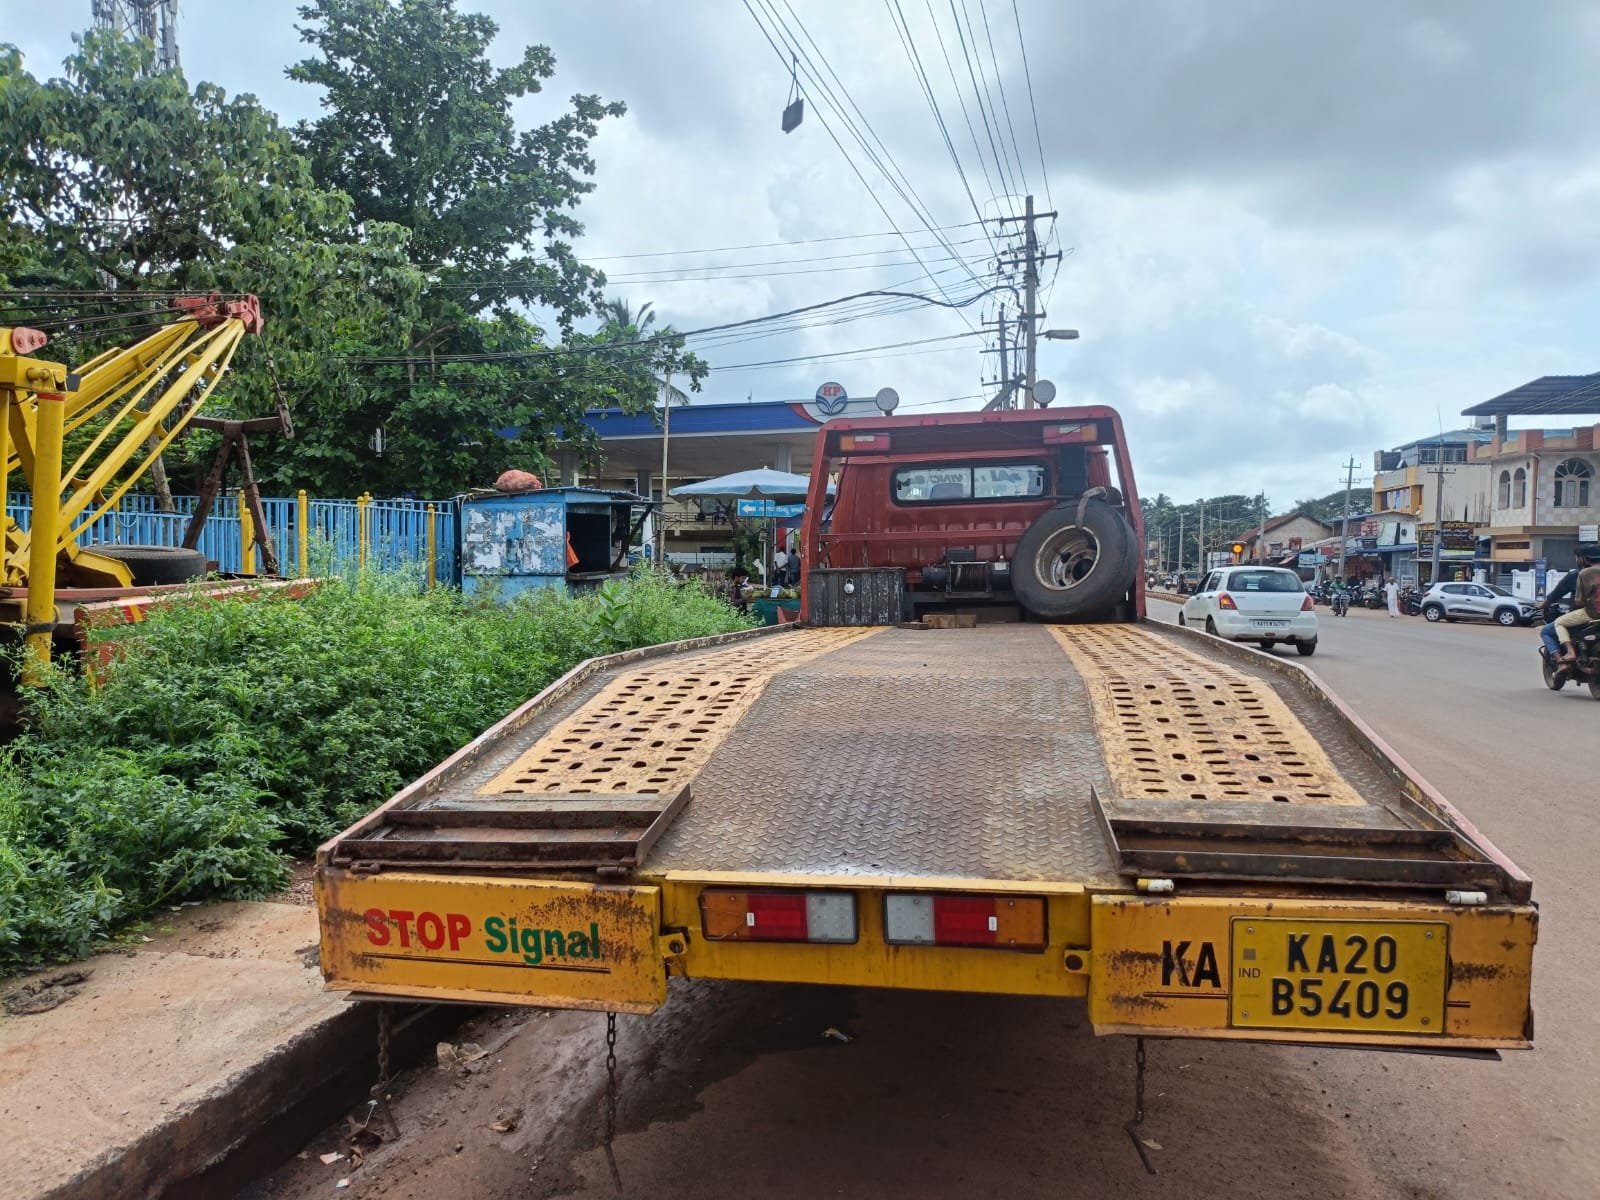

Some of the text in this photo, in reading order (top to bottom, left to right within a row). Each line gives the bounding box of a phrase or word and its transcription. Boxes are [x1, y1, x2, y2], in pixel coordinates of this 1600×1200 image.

[823, 386, 841, 397] HP
[363, 907, 602, 965] STOP Signal
[1287, 932, 1397, 974] KA20
[1161, 939, 1221, 988] KA
[1238, 967, 1261, 979] IND
[1271, 977, 1409, 1020] B5409
